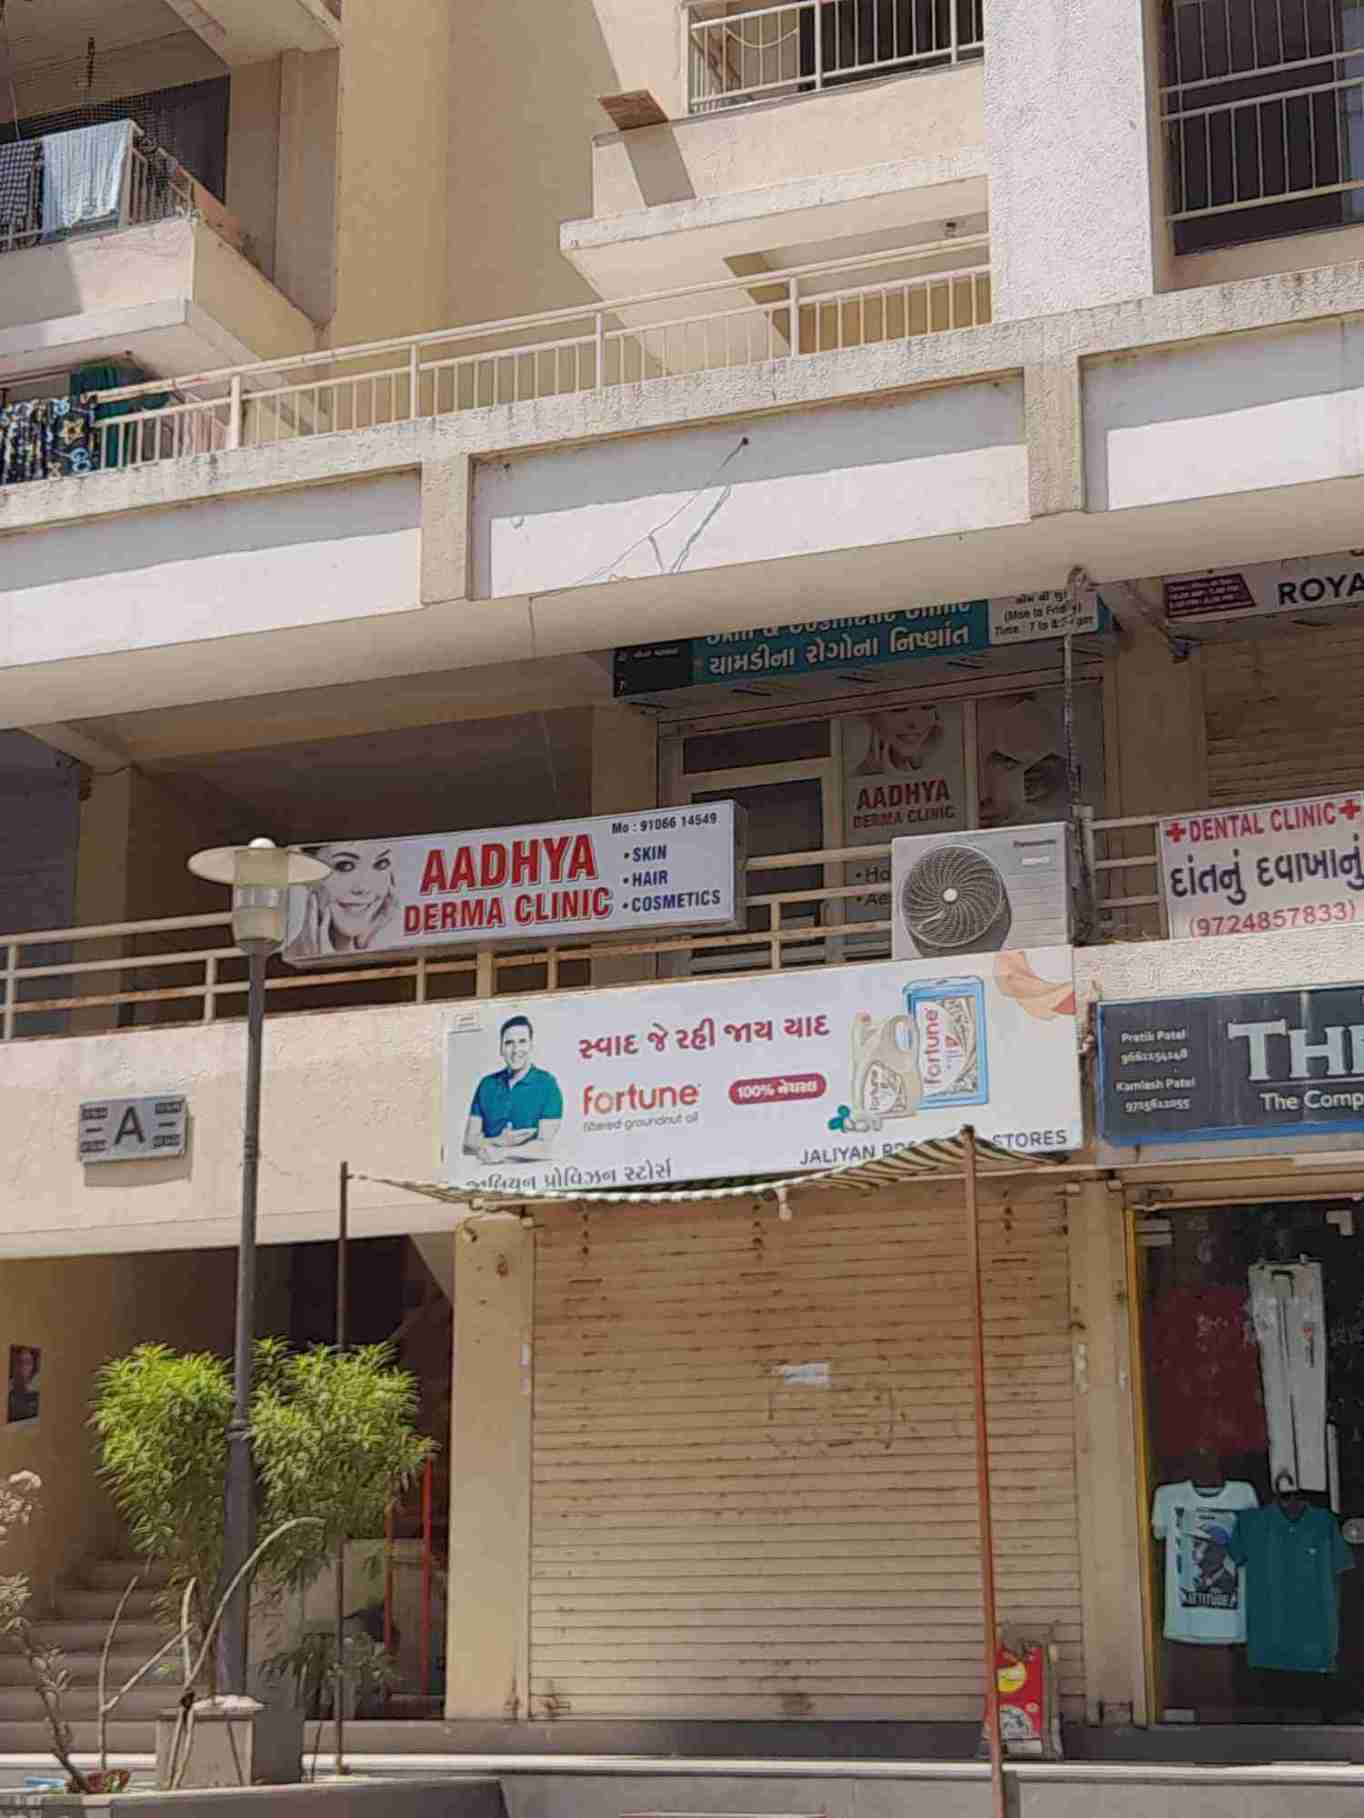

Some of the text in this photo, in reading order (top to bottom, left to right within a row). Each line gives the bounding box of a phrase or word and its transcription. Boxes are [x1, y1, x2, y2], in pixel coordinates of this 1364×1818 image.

[805, 636, 879, 664] રોગોના
[856, 777, 950, 810] AADHYA
[853, 804, 956, 829] DERMA CLINIC
[1189, 801, 1336, 843] DENTAL CLINIC
[420, 834, 599, 895] AADHYA
[632, 845, 667, 862] SKIN
[632, 870, 669, 887] HAIR
[1170, 849, 1247, 906] દાંતનું
[403, 887, 613, 936] DERMA CLINIC
[631, 889, 721, 913] COSMETICS
[1190, 899, 1356, 938] (9724857833)
[578, 1014, 830, 1060] સ્વાદ જે રહી જાય યાદ
[583, 1082, 699, 1116] fortune
[1260, 1091, 1300, 1112] The
[113, 1105, 147, 1145] A
[991, 1128, 1068, 1150] STORES
[800, 1143, 876, 1166] JALIYAN
